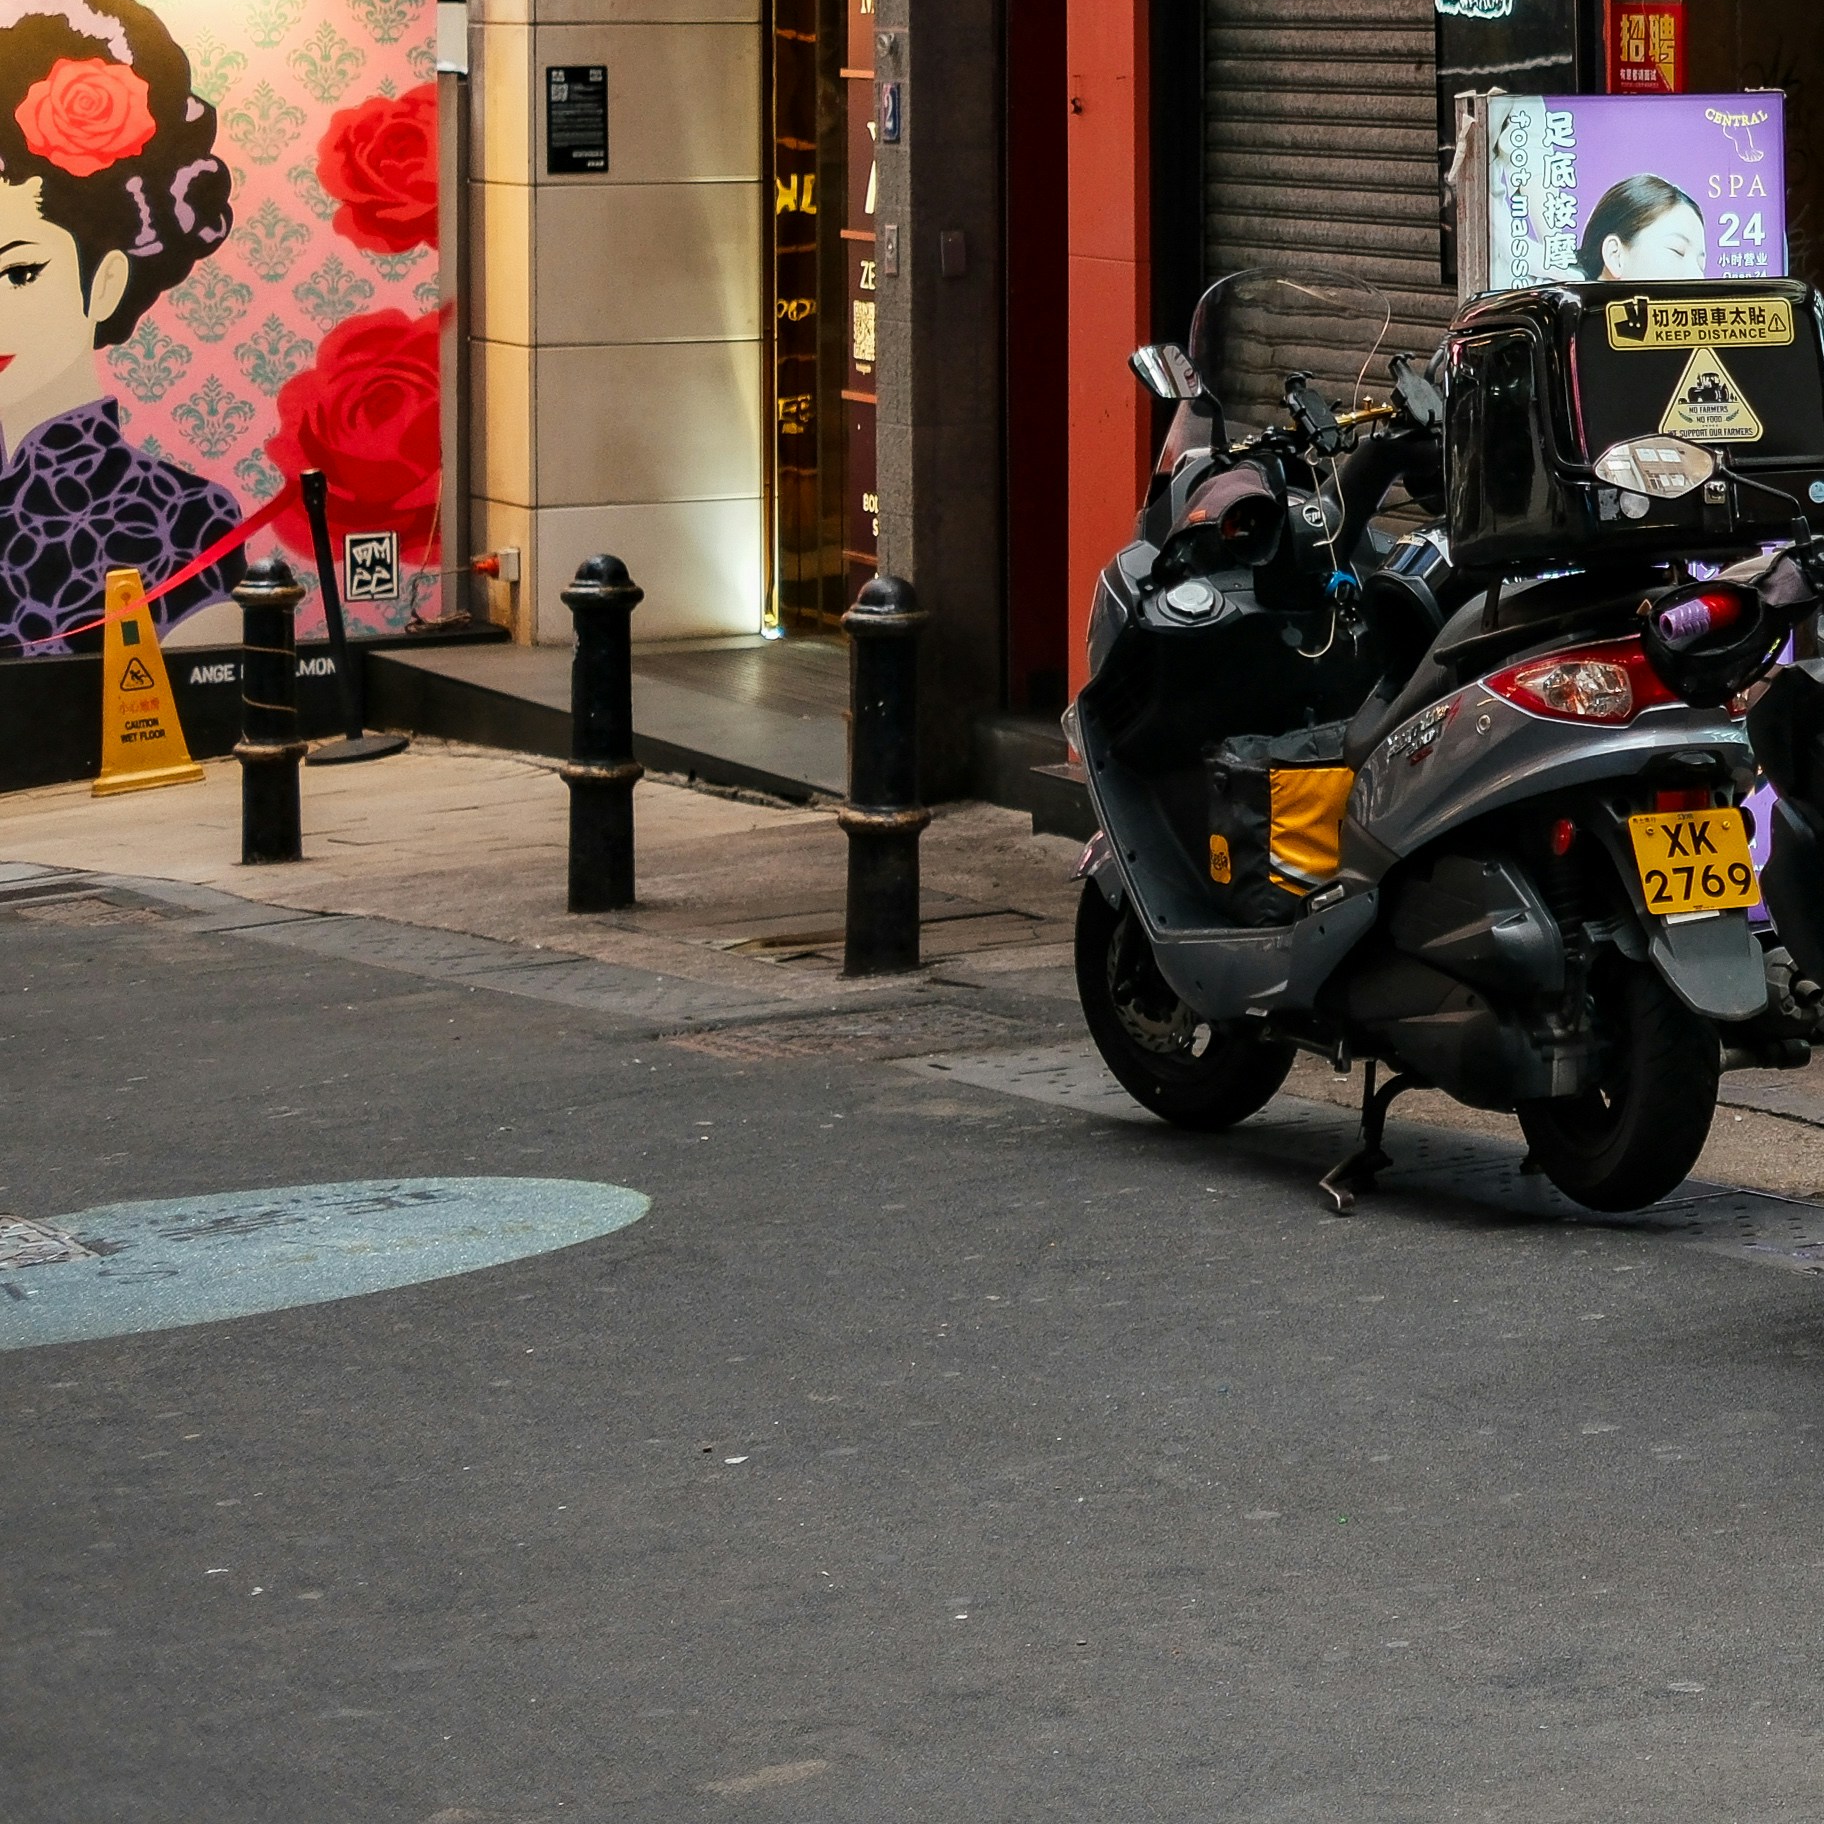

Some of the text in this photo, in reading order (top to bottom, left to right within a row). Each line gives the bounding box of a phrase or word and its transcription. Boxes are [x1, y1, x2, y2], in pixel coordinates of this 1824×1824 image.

[1620, 14, 1675, 64] 招聘
[1704, 106, 1769, 128] CENTRAL
[1509, 110, 1532, 188] foot
[1542, 110, 1579, 271] 足底按摩
[1707, 174, 1768, 199] SPA
[1717, 211, 1766, 248] 24
[1717, 251, 1769, 268] 小时营业
[1652, 306, 1767, 327] 切勿跟車太貼
[1655, 328, 1768, 342] KEEP DISTANCE
[1699, 405, 1729, 414] FARMERS
[1707, 415, 1724, 424] FOOD
[1724, 427, 1754, 436] FARMERS
[189, 664, 236, 685] ANGE
[124, 717, 160, 732] CAUTION
[120, 730, 166, 744] WET FLOOR
[1661, 821, 1718, 858] XK
[1645, 862, 1752, 904] 2769
